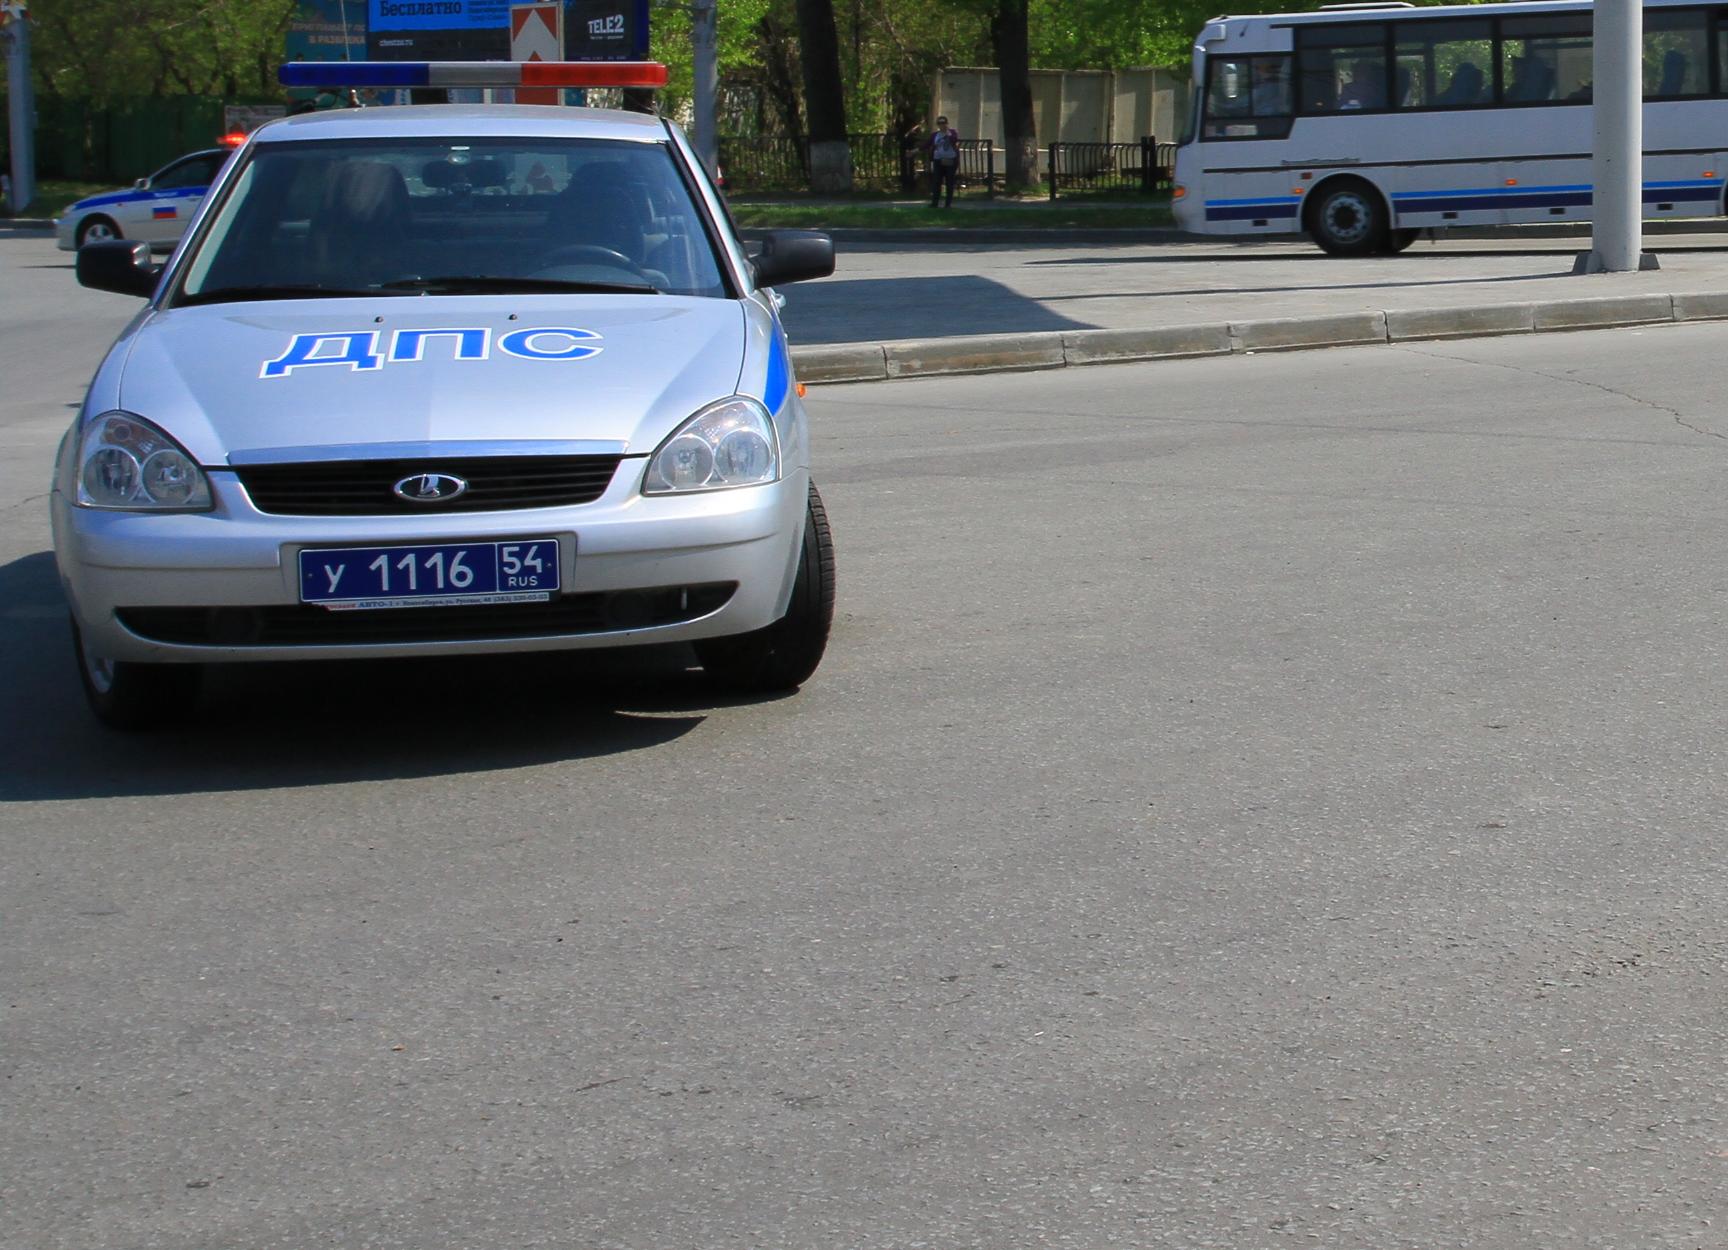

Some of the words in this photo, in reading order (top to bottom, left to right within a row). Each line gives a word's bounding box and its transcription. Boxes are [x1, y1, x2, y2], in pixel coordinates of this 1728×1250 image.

[380, 1, 462, 16] Бесплатно
[588, 14, 624, 34] TELE2
[259, 327, 604, 379] ДПС
[369, 551, 474, 591] 1116
[502, 545, 542, 575] 54
[508, 576, 538, 587] RUS
